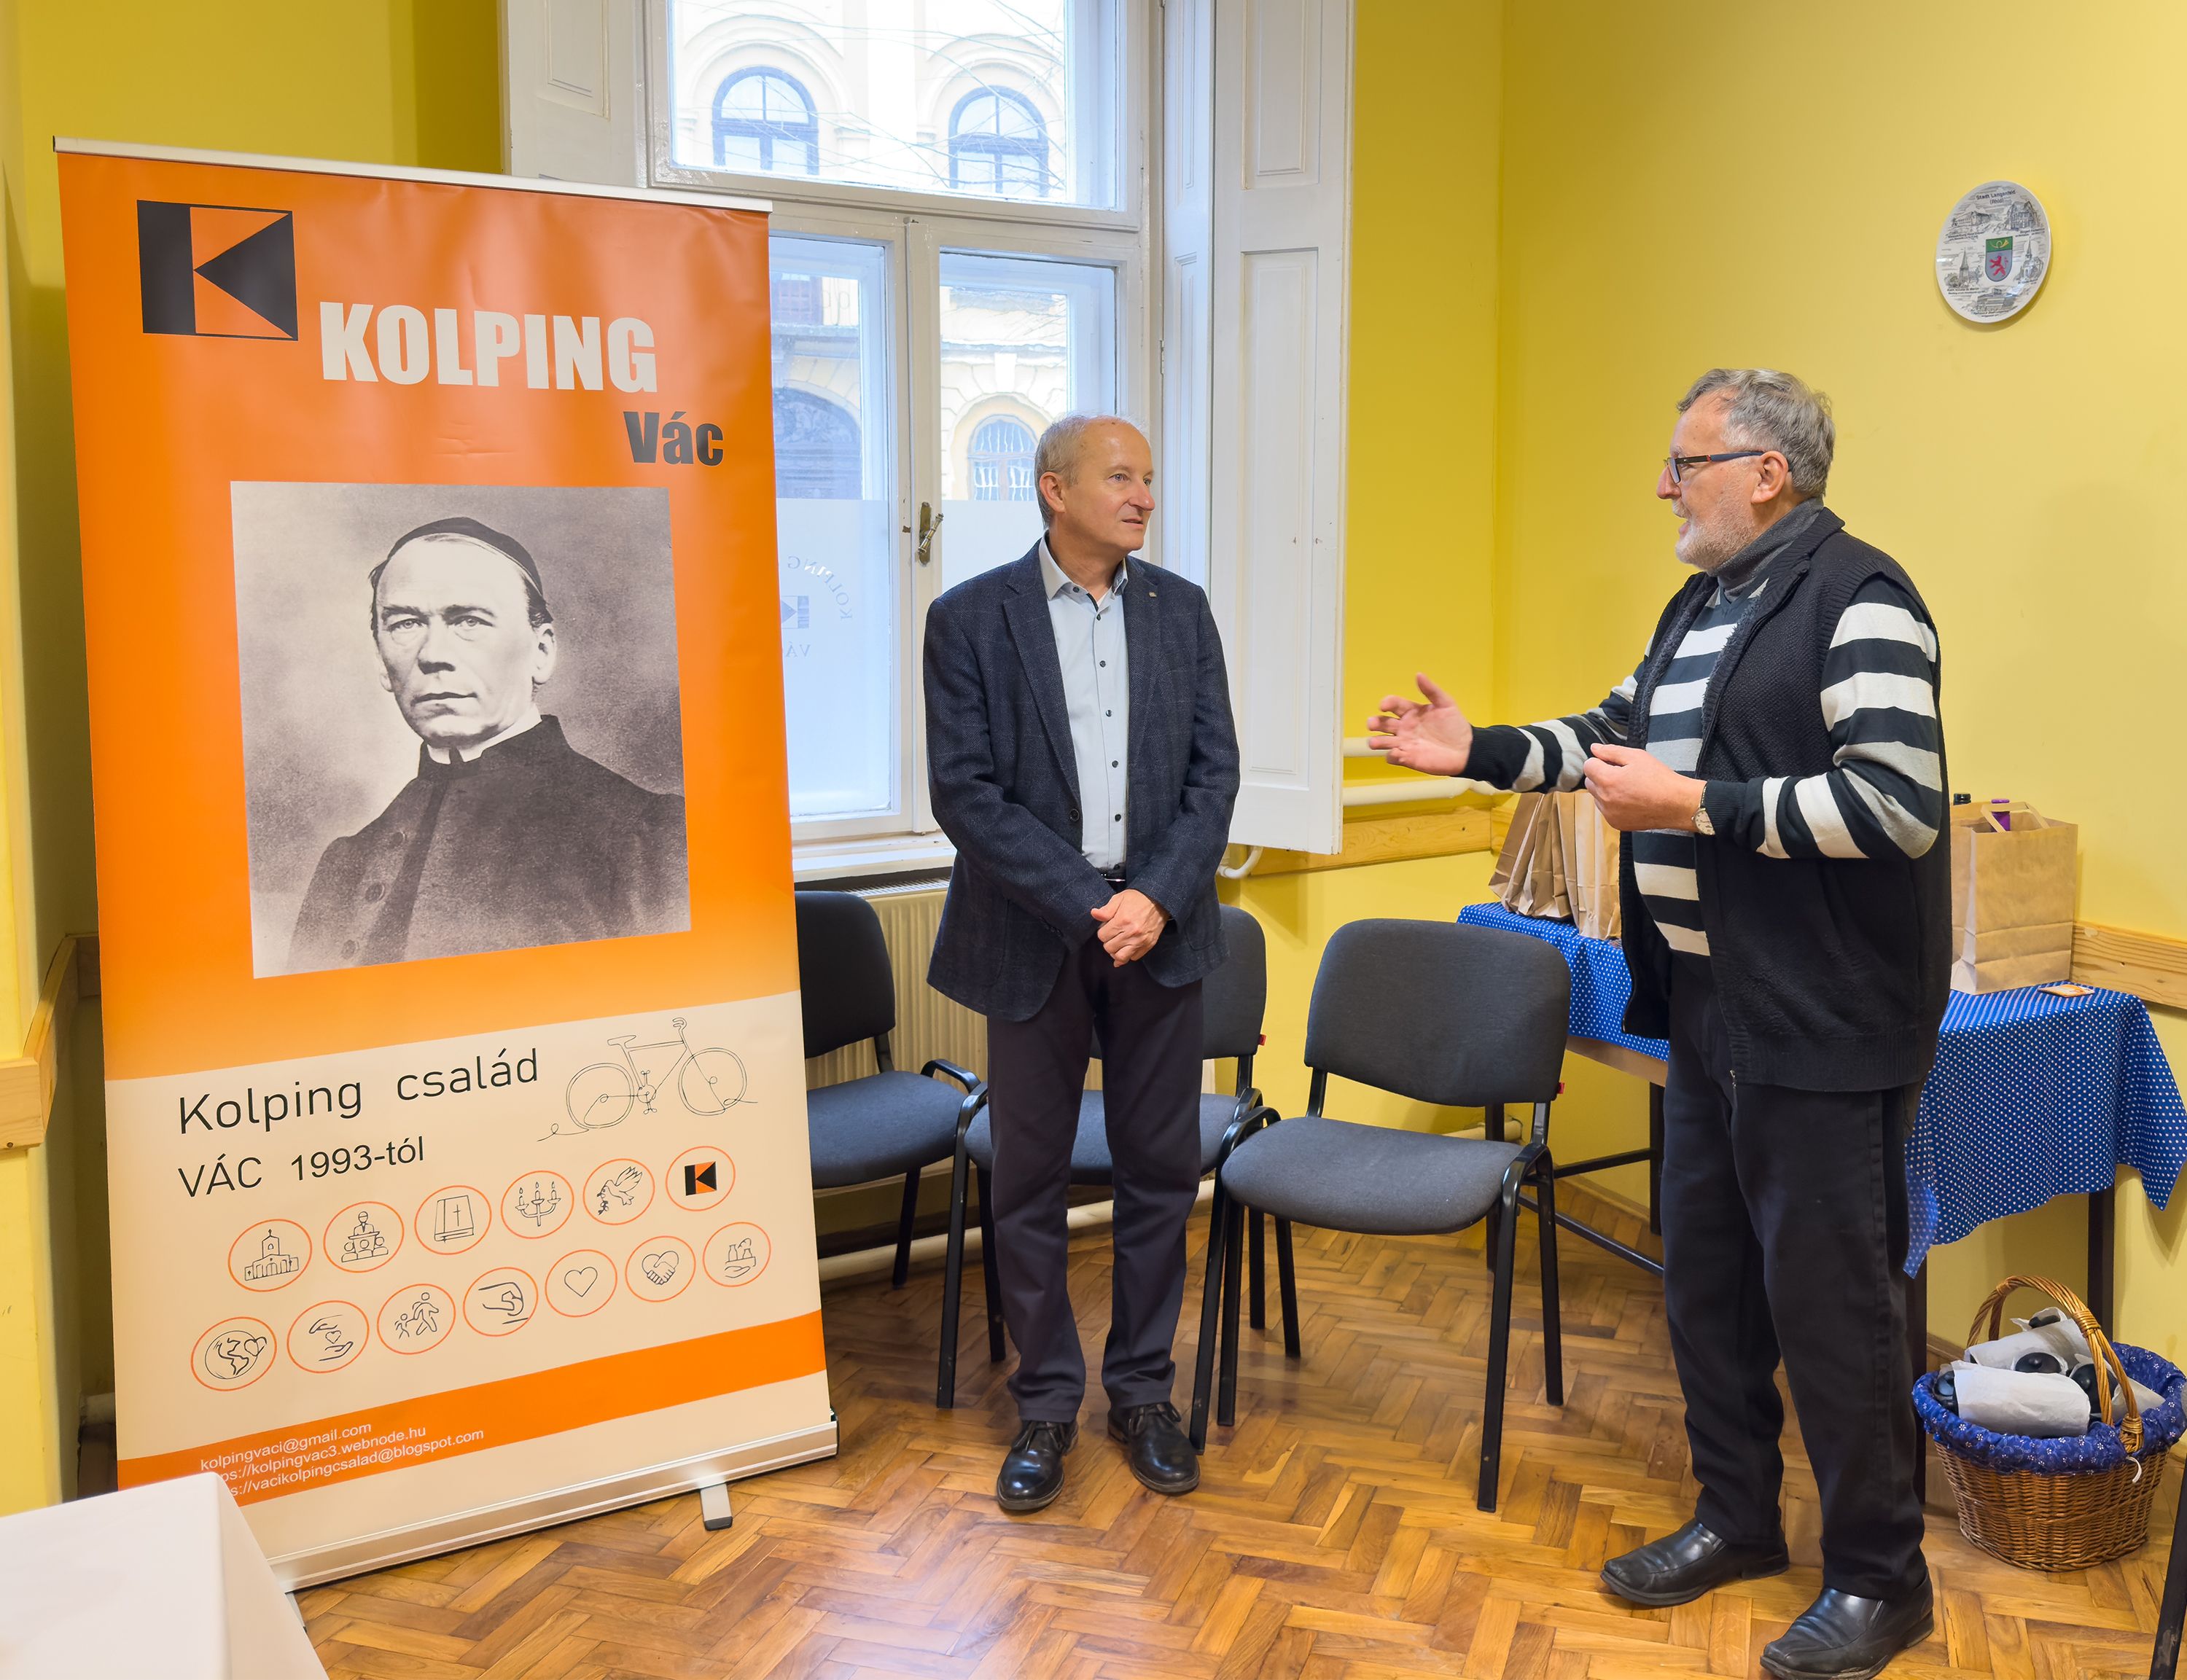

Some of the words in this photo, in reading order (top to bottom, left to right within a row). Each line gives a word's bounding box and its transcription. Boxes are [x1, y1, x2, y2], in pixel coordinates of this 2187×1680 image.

[1990, 190, 2016, 198] Langenfeld
[319, 301, 660, 394] KOLPING
[623, 410, 724, 467] Vác
[179, 1081, 362, 1134] Kolping
[397, 1047, 538, 1101] család
[177, 1153, 263, 1198] VÁC
[291, 1136, 424, 1181] 1993-tól
[200, 1423, 372, 1472] kolpingvaci@gmail.com
[220, 1426, 427, 1482] ps://kolpingvac3.webnode.hu
[230, 1429, 485, 1496] s://vacikolpingcsalad@blogspot.com
